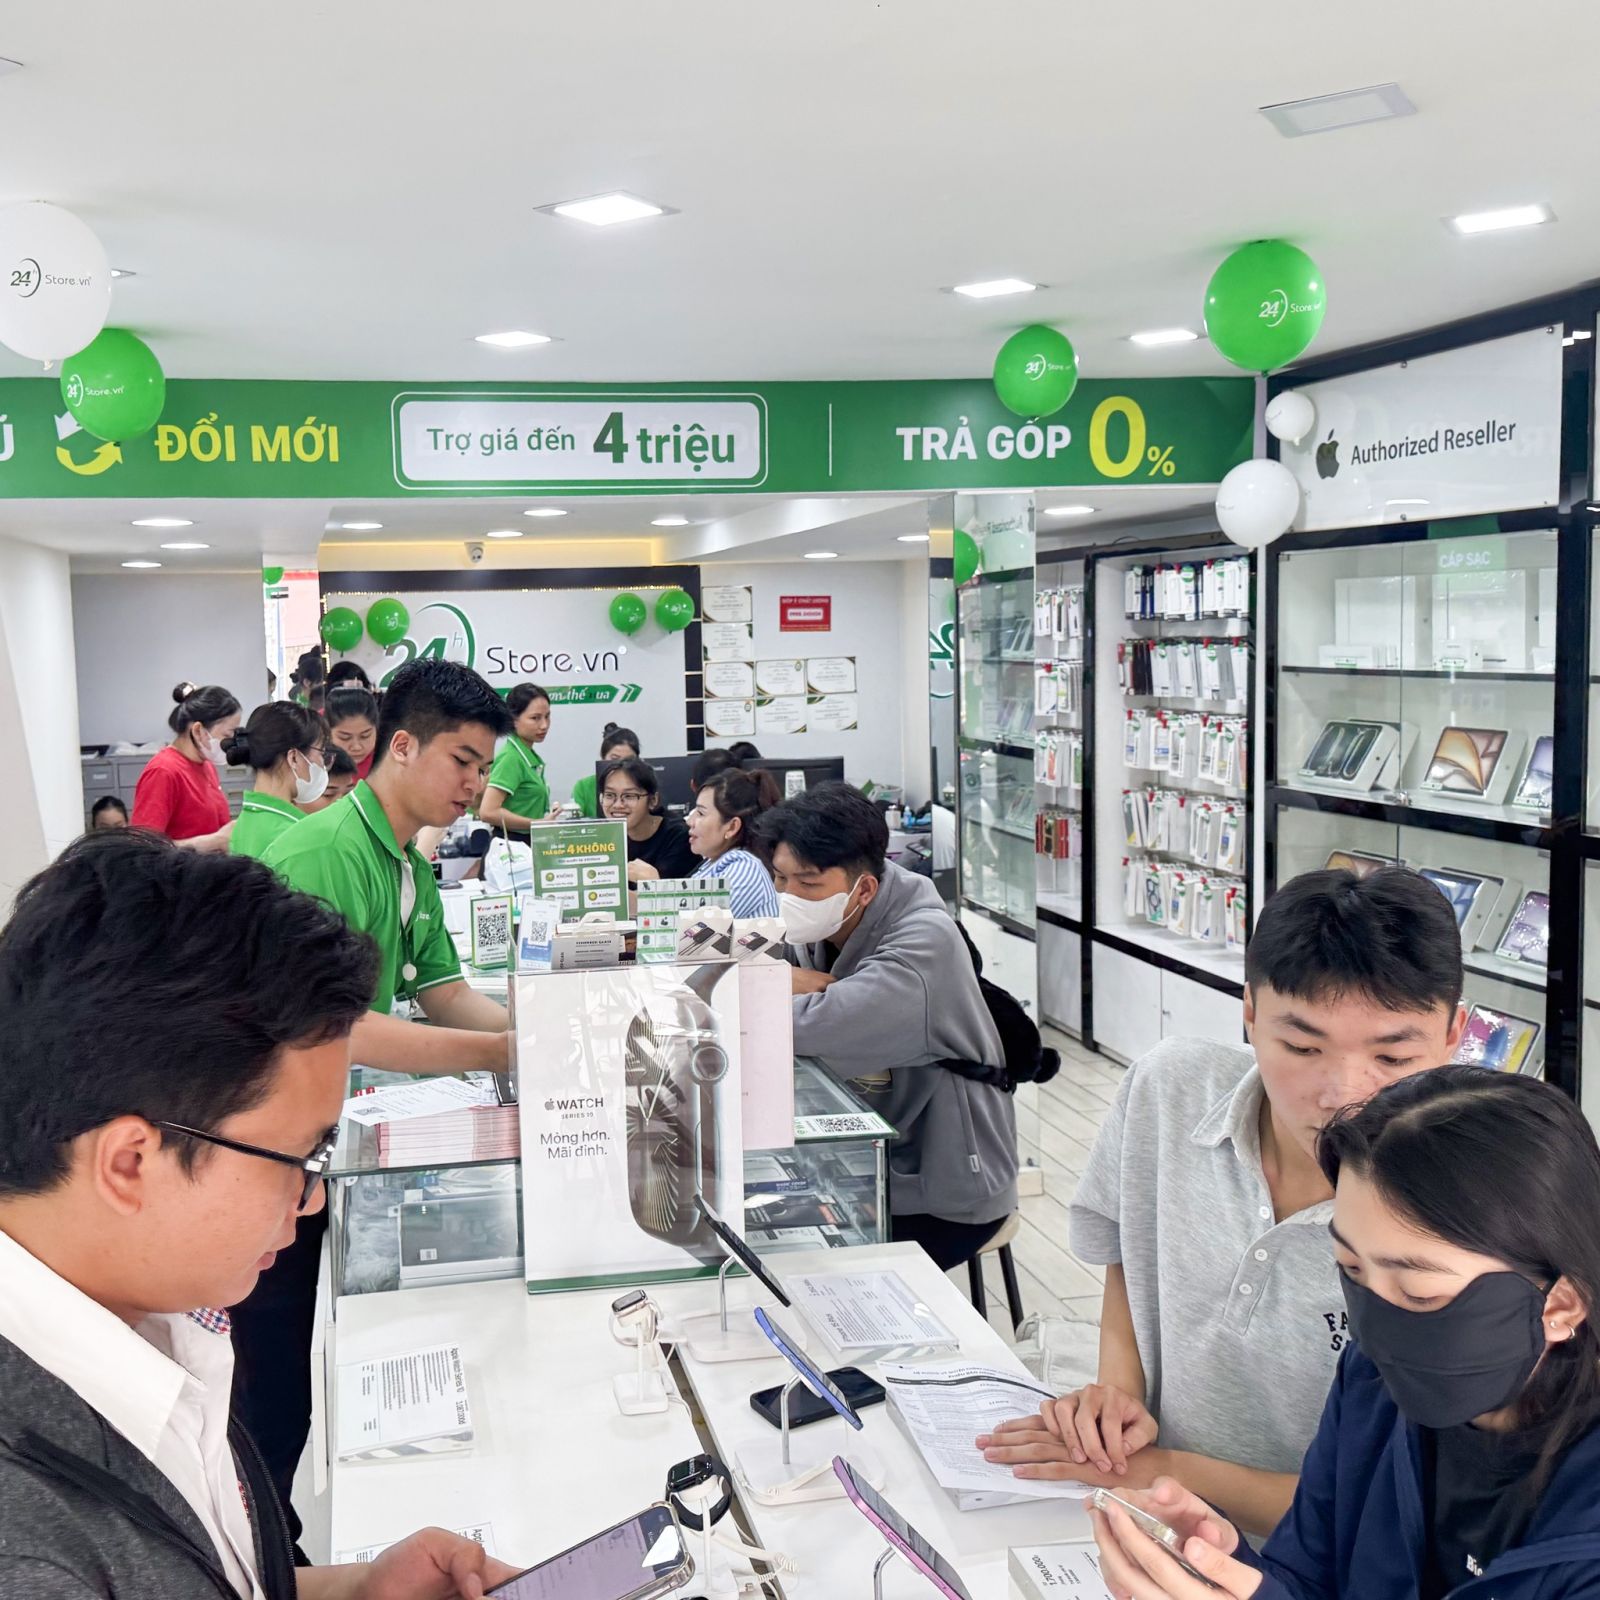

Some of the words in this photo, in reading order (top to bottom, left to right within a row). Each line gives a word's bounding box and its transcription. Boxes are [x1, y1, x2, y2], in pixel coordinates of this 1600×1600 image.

[45, 275, 92, 287] Store.vn
[154, 412, 236, 463] ĐỔI
[252, 416, 340, 463] MỚI
[427, 428, 470, 456] Trợ
[479, 428, 519, 457] giá
[527, 425, 576, 451] đến
[593, 411, 629, 464] 4
[637, 422, 736, 473] triệu
[896, 416, 978, 461] TRẢ
[987, 417, 1072, 461] GÓP
[1351, 430, 1439, 466] Authorized
[1443, 420, 1516, 452] Reseller
[487, 646, 619, 674] Store.vn
[576, 842, 616, 854] KHÔNG
[557, 1097, 604, 1110] WATCH
[540, 1132, 579, 1146] Mỏng
[582, 1130, 611, 1142] hơn.
[548, 1146, 572, 1160] Mãi
